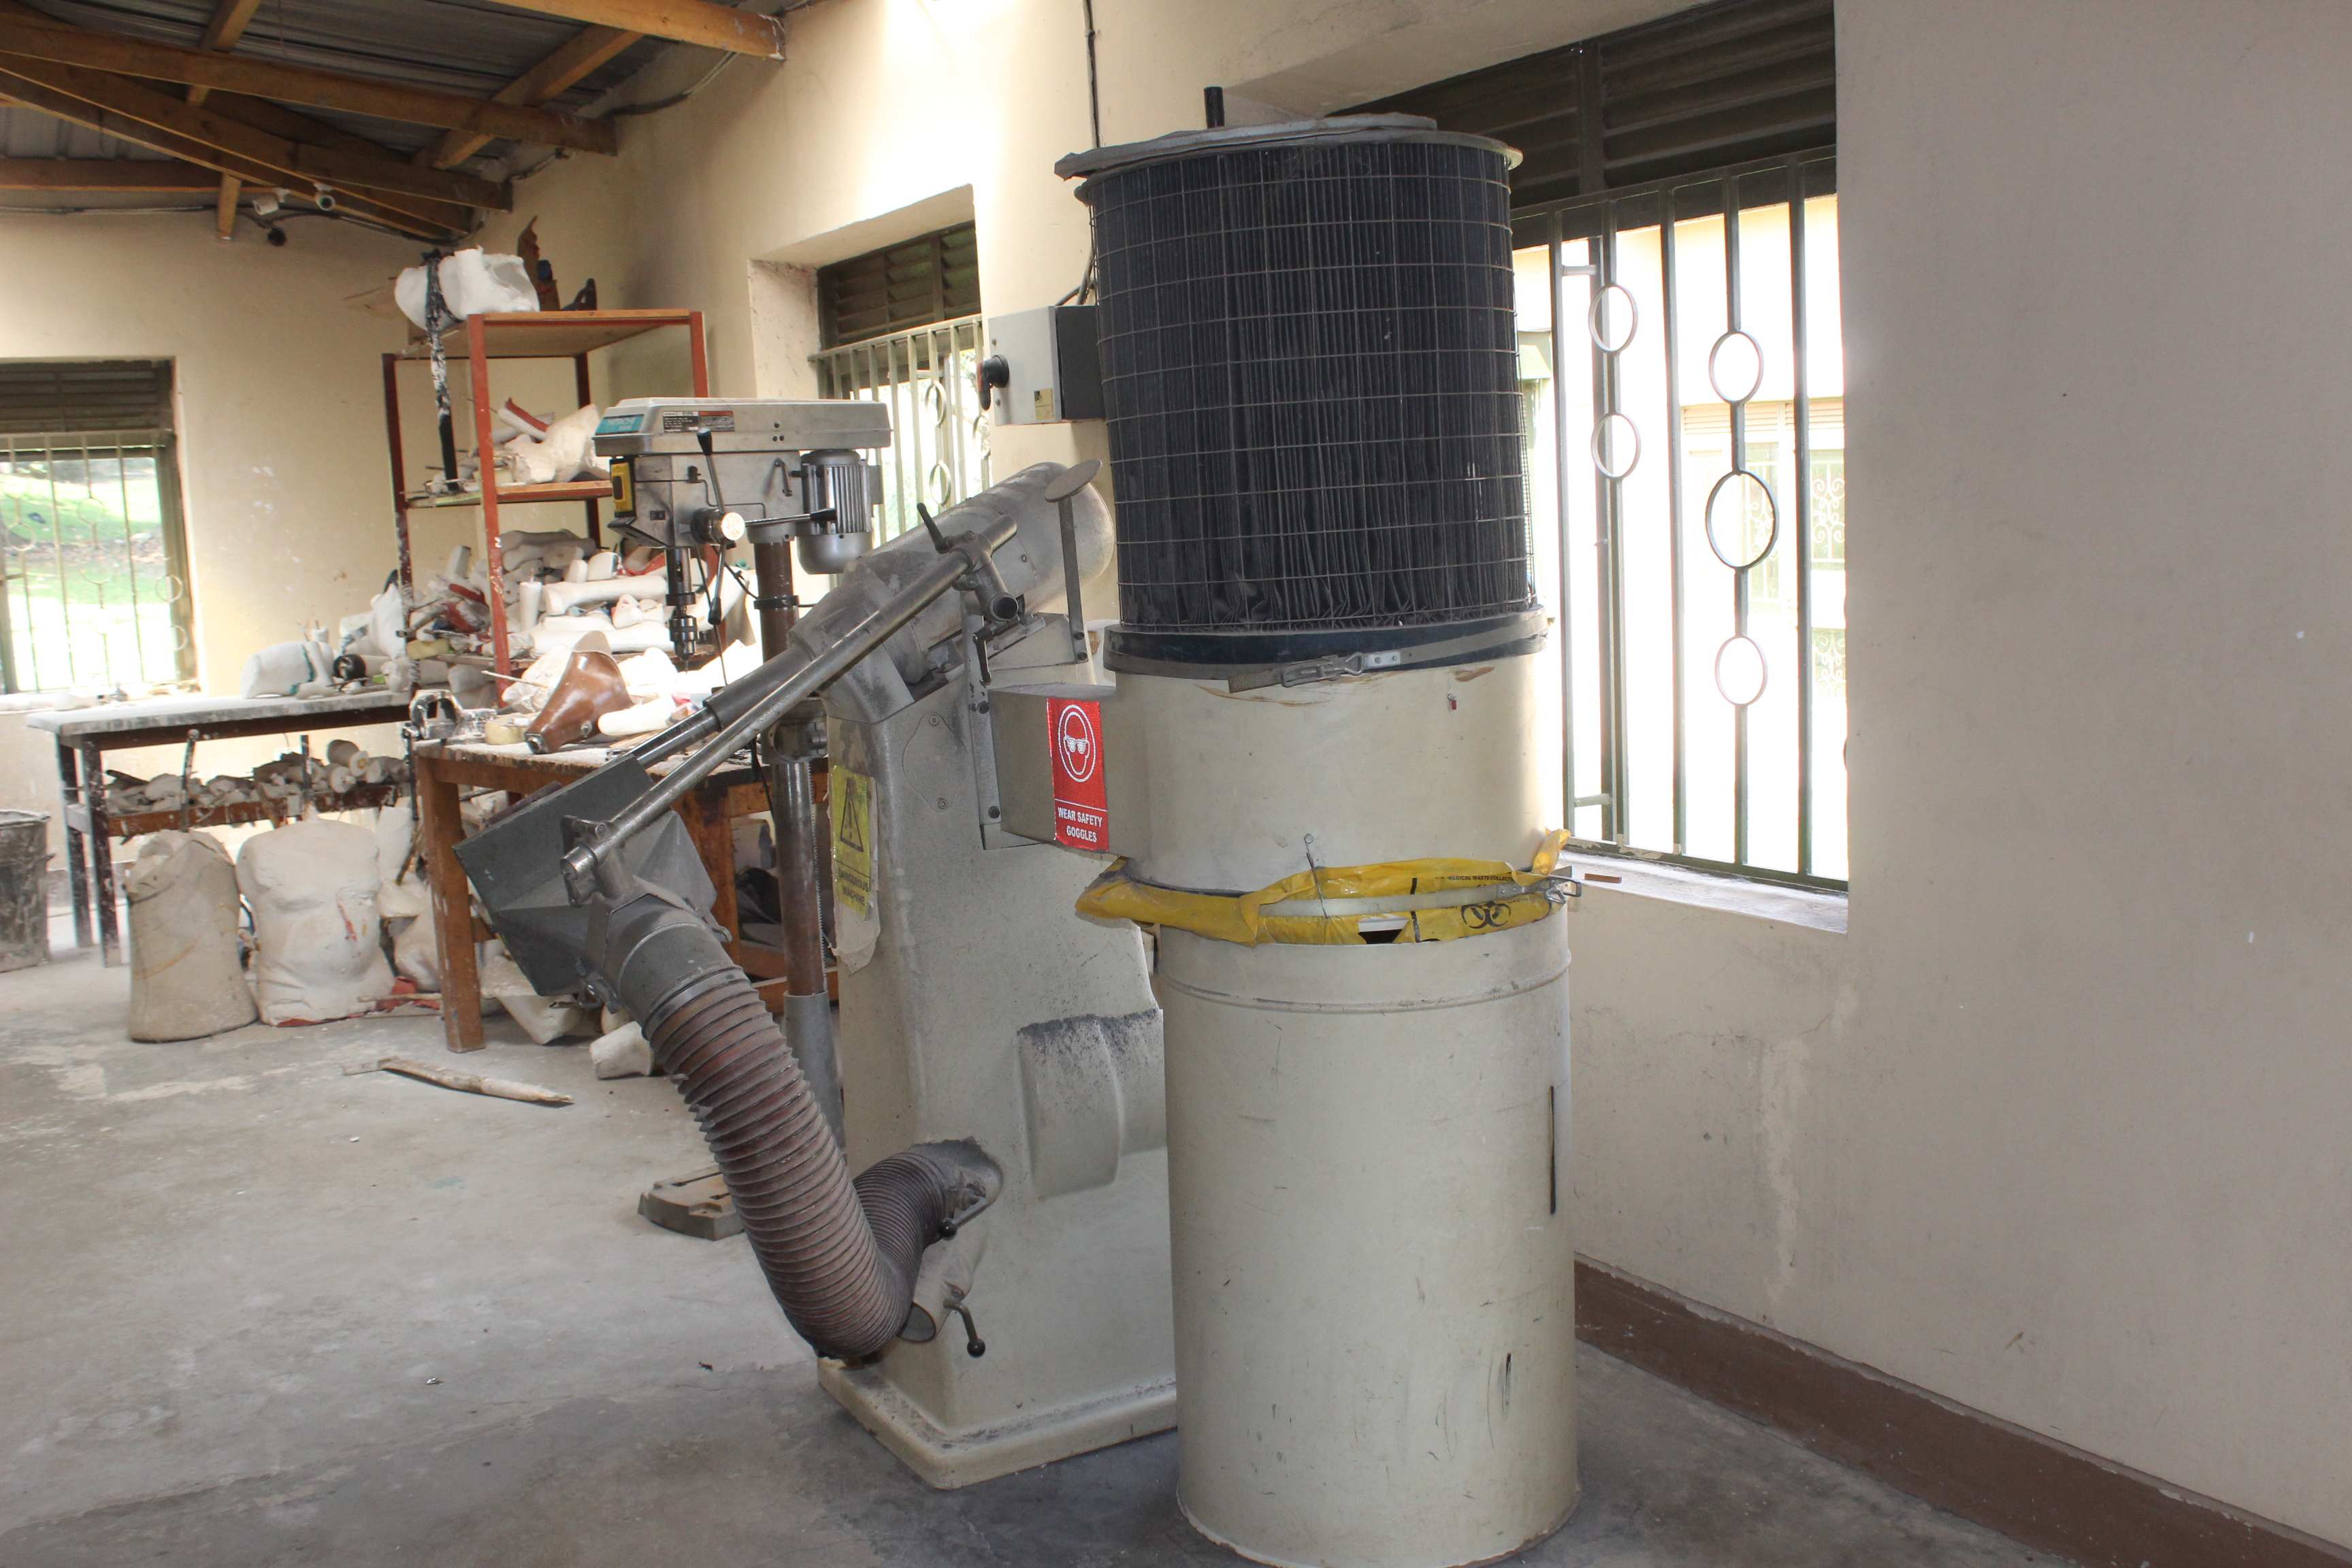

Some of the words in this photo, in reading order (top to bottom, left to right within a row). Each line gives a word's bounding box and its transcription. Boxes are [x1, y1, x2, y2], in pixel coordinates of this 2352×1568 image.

[1058, 806, 1076, 821] WEAR
[1077, 811, 1102, 828] SAFETY
[1066, 825, 1097, 843] GOGGLES
